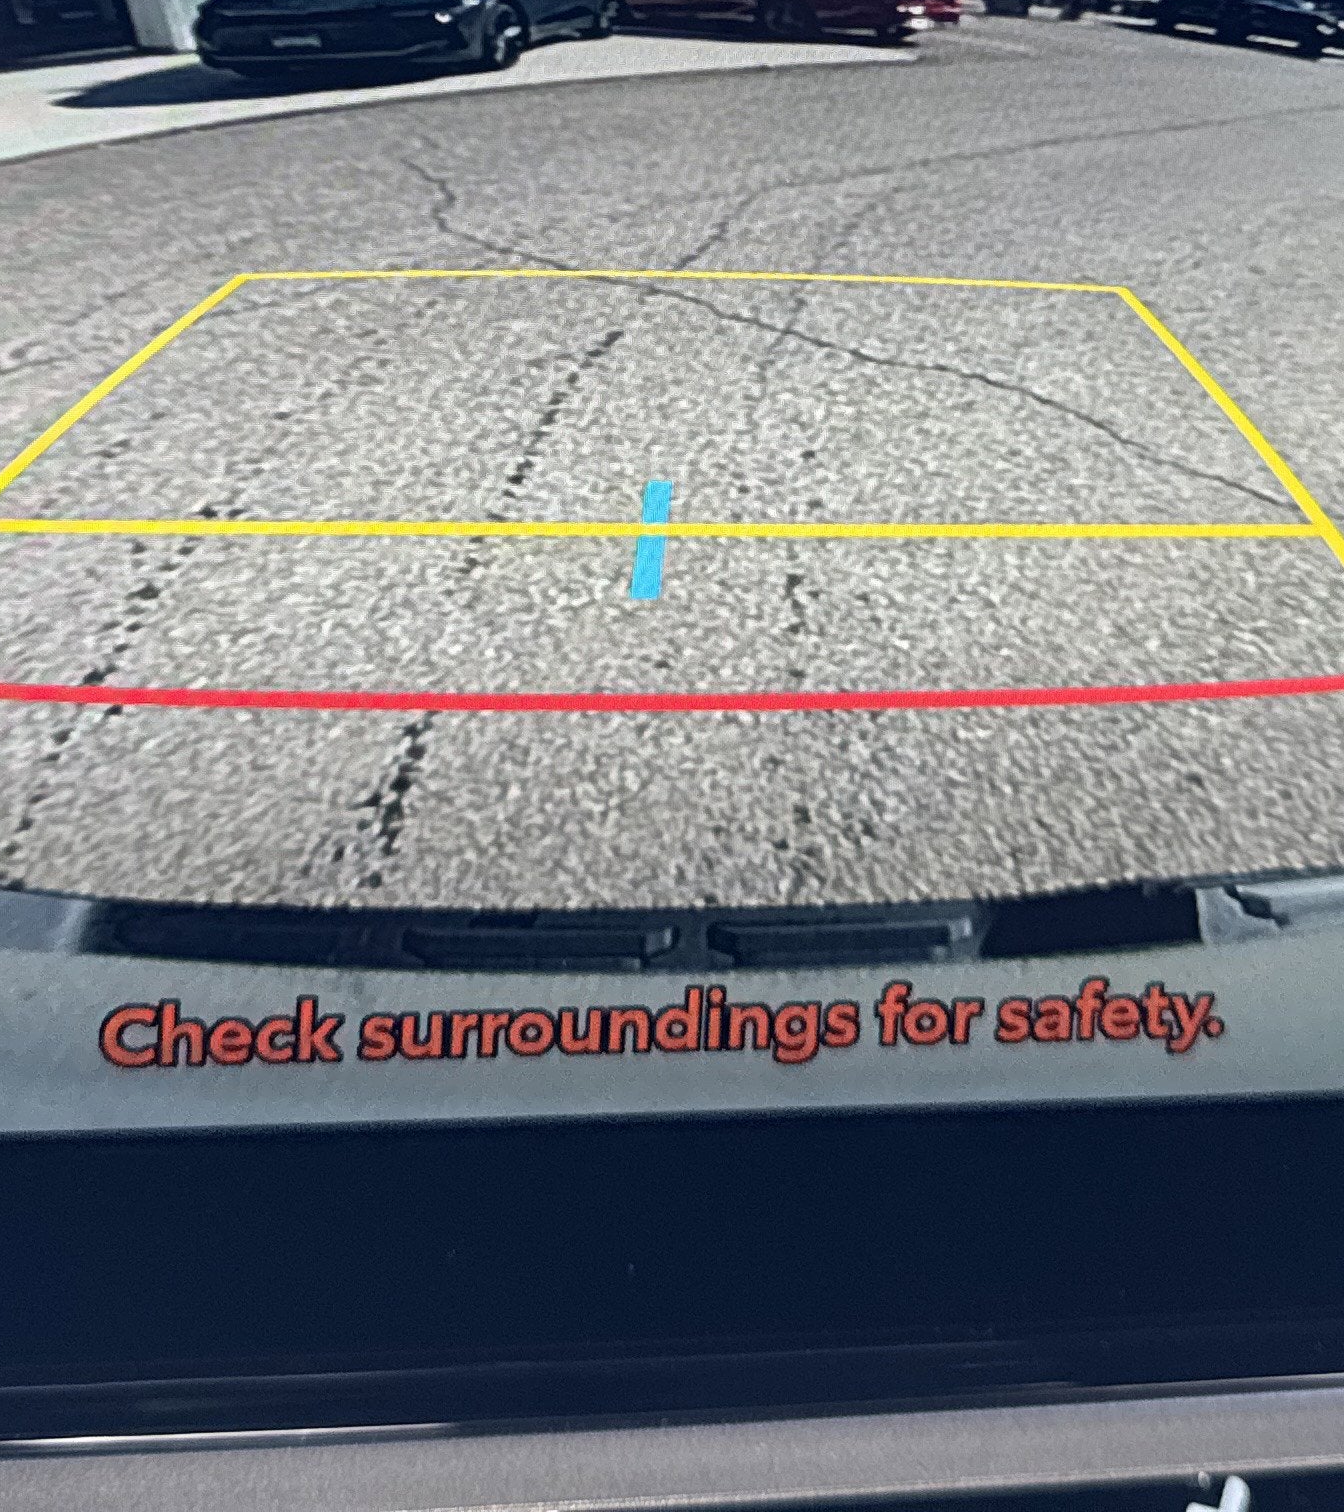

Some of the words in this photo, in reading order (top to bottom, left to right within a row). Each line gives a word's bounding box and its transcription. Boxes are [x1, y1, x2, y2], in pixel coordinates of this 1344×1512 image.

[99, 994, 345, 1068] Check
[356, 984, 860, 1065] surroundings
[877, 978, 985, 1046] for
[995, 975, 1225, 1054] safety.
